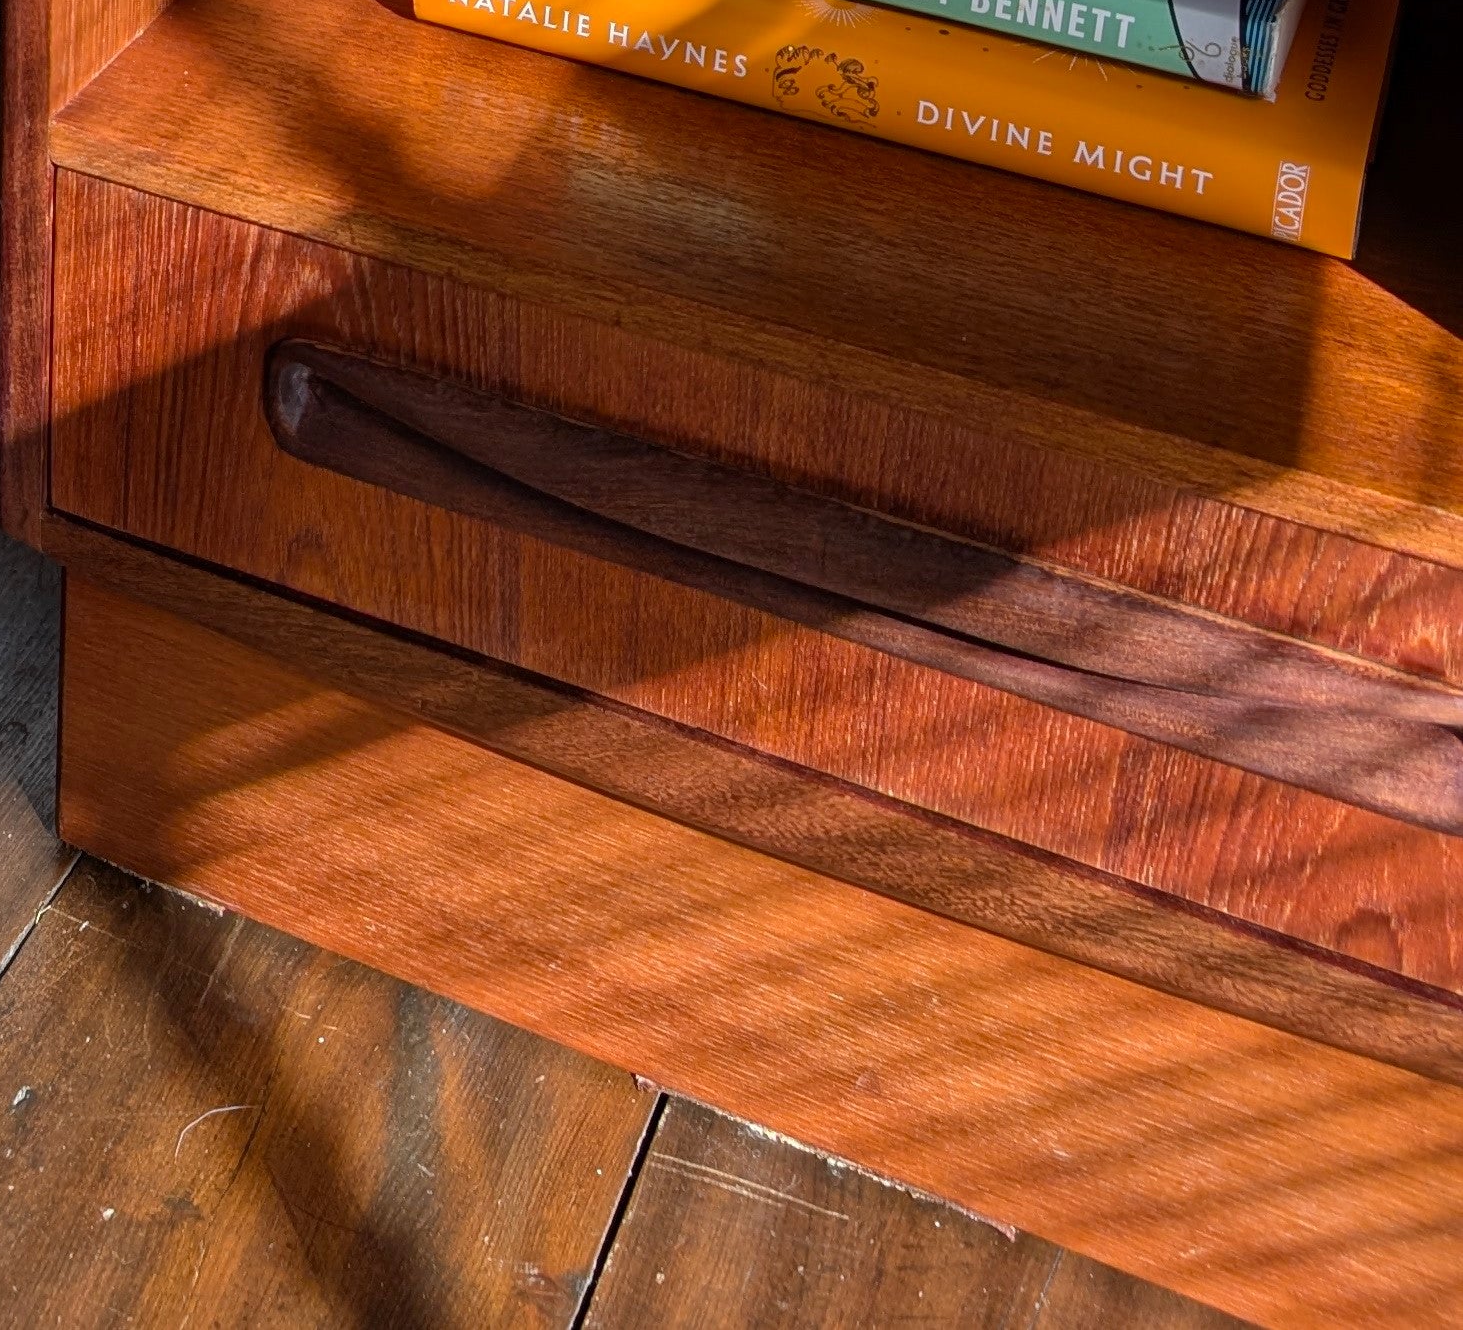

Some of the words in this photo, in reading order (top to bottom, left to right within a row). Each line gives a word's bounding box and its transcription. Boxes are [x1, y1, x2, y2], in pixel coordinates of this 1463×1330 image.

[608, 22, 748, 78] HAYNES
[916, 100, 1053, 156] DIVINE
[1073, 141, 1215, 196] MIGHT
[1272, 161, 1310, 241] PICADOR
